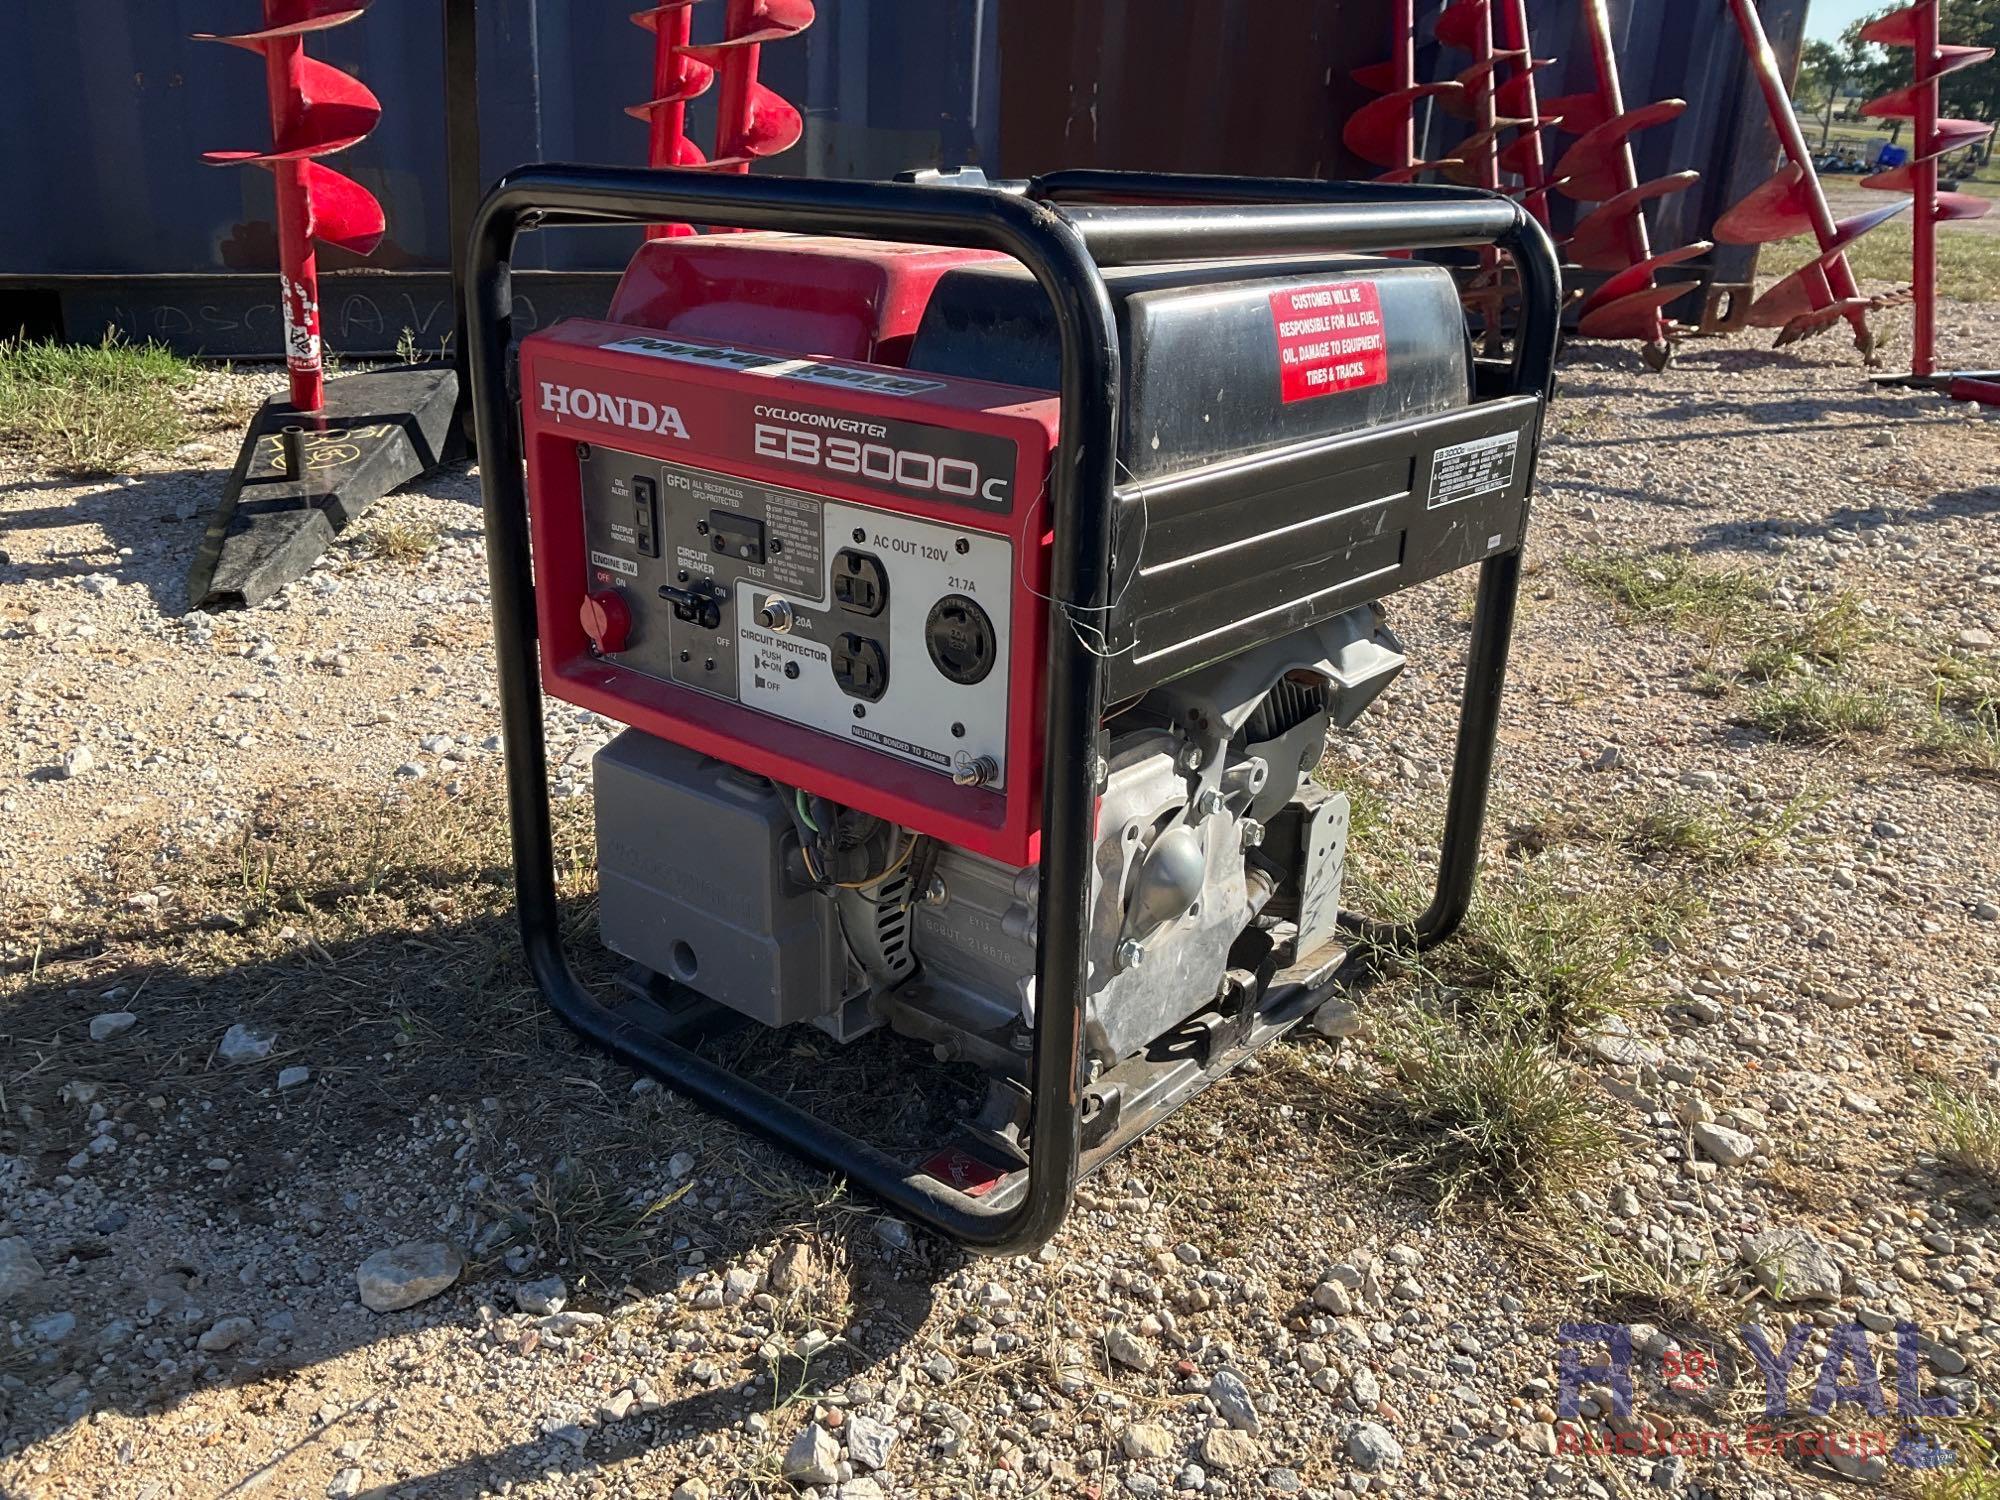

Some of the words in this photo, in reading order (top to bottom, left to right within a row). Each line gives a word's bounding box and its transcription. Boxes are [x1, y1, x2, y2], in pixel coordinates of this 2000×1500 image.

[1291, 291, 1333, 310] CUSTOMER
[1332, 289, 1350, 304] WILL
[1350, 288, 1361, 303] BE
[1279, 317, 1331, 338] RESPONSIBLE
[1331, 314, 1346, 330] FOR
[1347, 313, 1360, 328] ALL
[1360, 311, 1379, 327] FUEL,
[1282, 348, 1299, 364] OIL,
[1299, 343, 1330, 361] DAMAGE
[1330, 340, 1340, 355] TO
[1342, 335, 1383, 354] EQUIPMENT,
[1306, 369, 1328, 386] TIRES
[1328, 367, 1335, 382] &
[1336, 361, 1365, 380] TRACKS.
[540, 381, 690, 440] HONDA
[754, 404, 887, 438] CYCLOCONVERTER
[615, 479, 624, 487] OIL
[667, 474, 690, 490] GFCI
[692, 479, 703, 490] ALL
[704, 482, 743, 499] RECEPTACLES
[611, 488, 629, 497] ALERT
[692, 490, 740, 508] GFCI-PROTECTED
[611, 523, 633, 535] OUTPUT
[611, 532, 635, 545] INDICATOR
[677, 546, 708, 562] CIRCUIT
[873, 534, 889, 549] AC
[892, 539, 917, 555] OUT
[921, 546, 948, 562] 120V
[593, 553, 620, 570] ENGINE
[622, 561, 637, 574] SW.
[677, 558, 714, 576] BREAKER
[597, 572, 609, 583] OFF
[748, 566, 766, 578] TEST
[616, 578, 626, 587] ON
[948, 576, 976, 592] 21.7A
[715, 587, 726, 598] ON
[795, 615, 812, 630] 20A
[716, 636, 730, 648] OFF
[740, 629, 774, 646] CIRCUIT
[761, 649, 782, 662] PUSH
[776, 640, 828, 662] PROTECTOR
[770, 662, 782, 673] ON
[767, 681, 780, 692] OFF
[852, 726, 880, 743] NEUTRAL
[883, 736, 910, 752] BONDED
[912, 746, 922, 755] TO
[923, 750, 948, 764] FRAME
